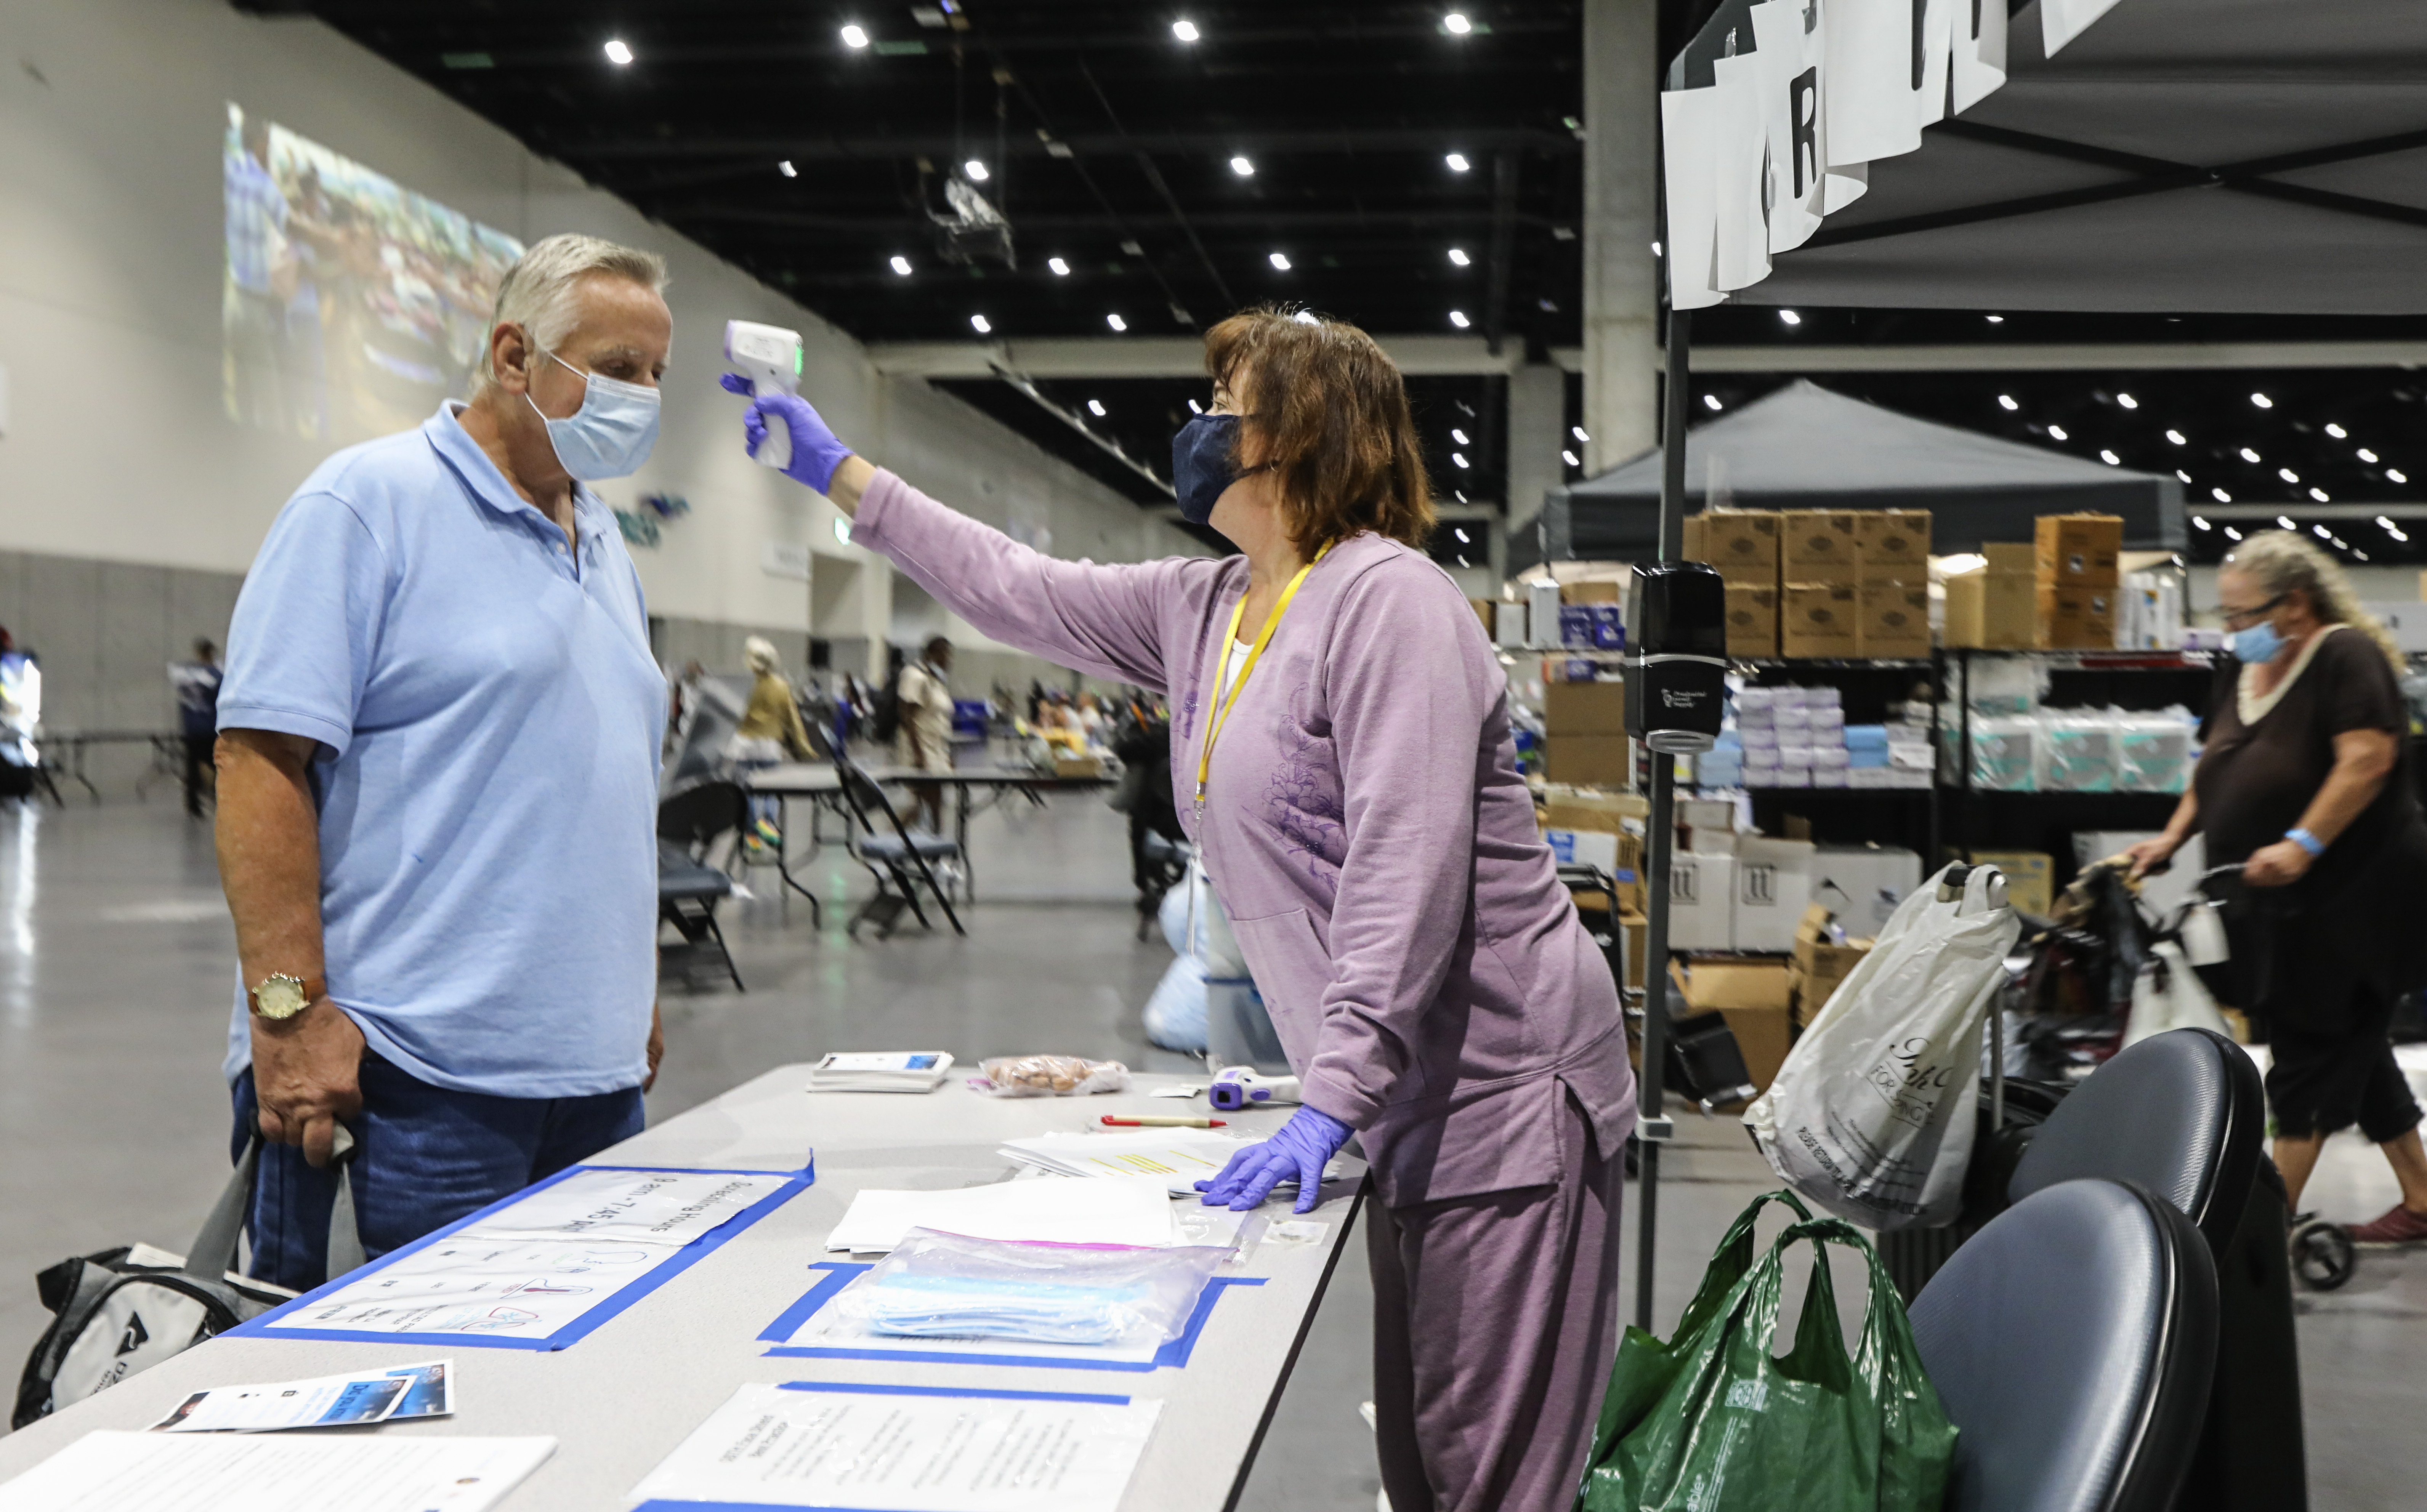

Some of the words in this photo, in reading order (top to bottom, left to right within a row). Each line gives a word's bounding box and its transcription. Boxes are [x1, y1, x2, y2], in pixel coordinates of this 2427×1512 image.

[628, 1183, 661, 1196] am
[681, 1181, 753, 1212] Screening
[650, 1212, 701, 1232] Hours
